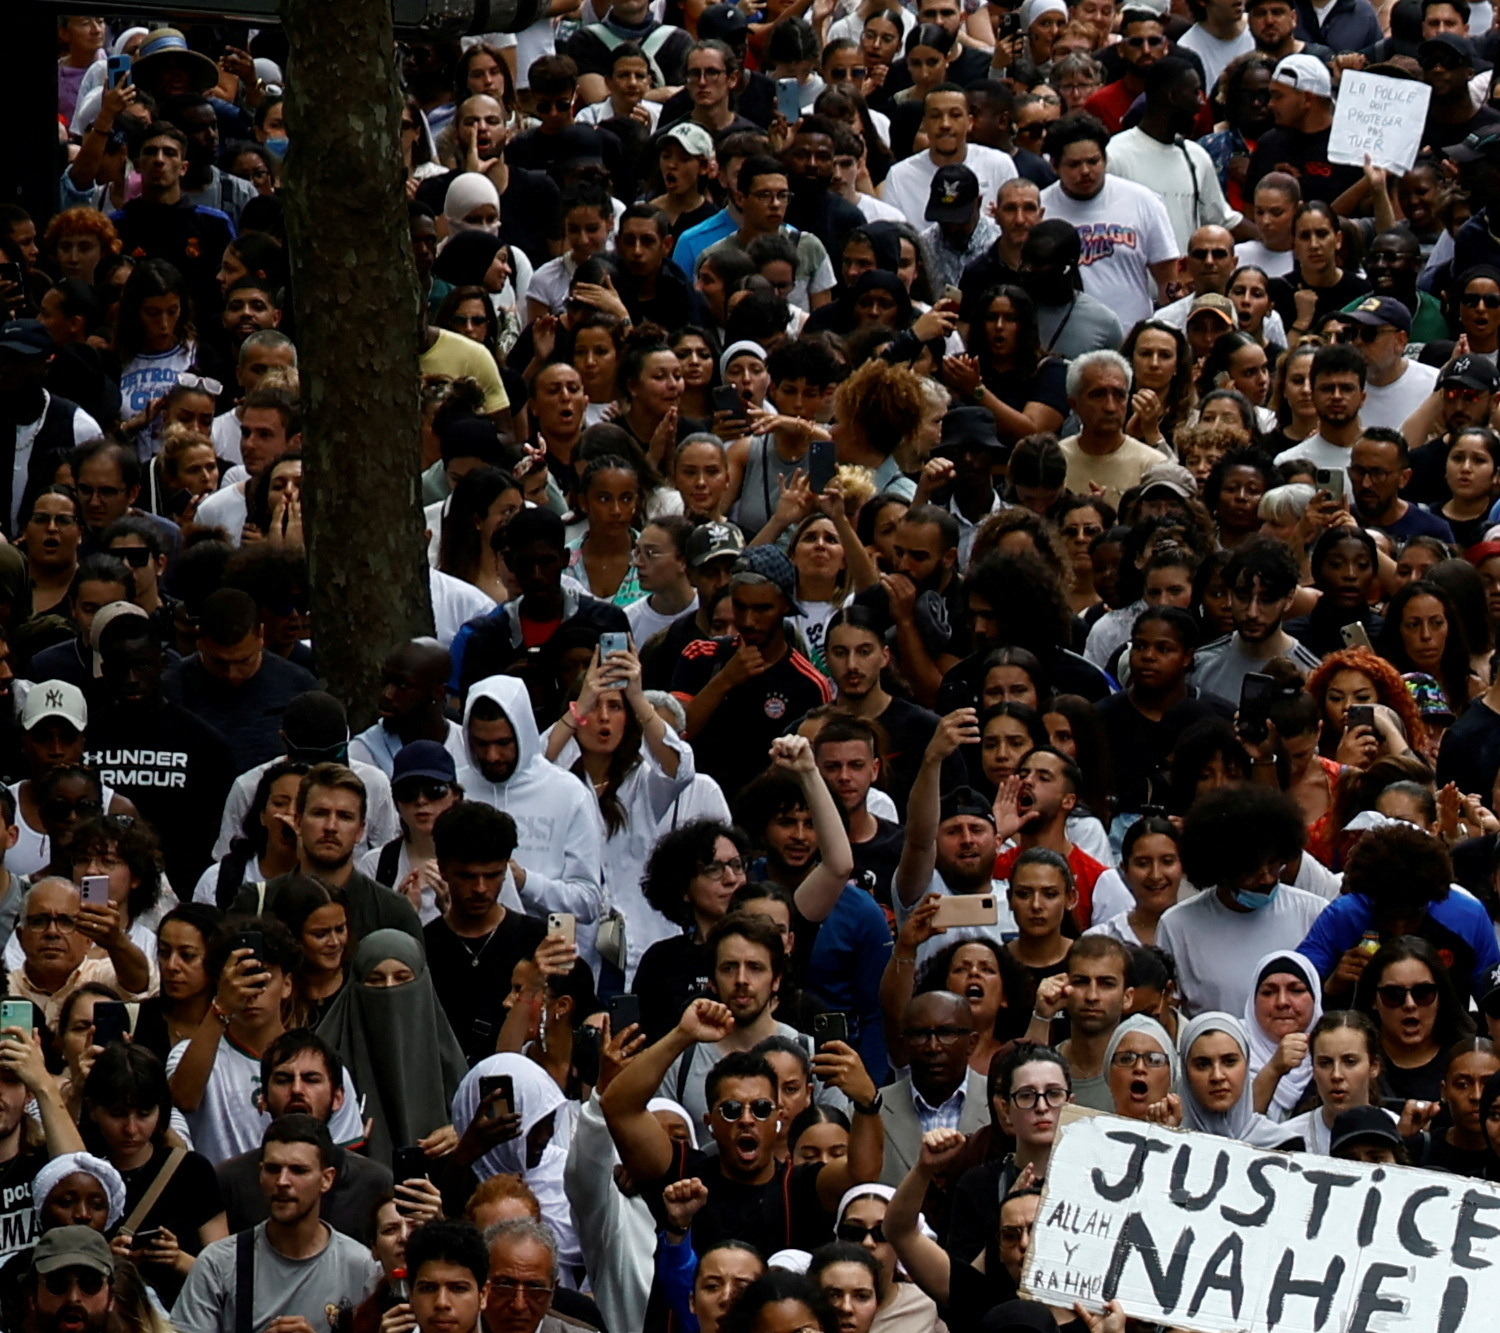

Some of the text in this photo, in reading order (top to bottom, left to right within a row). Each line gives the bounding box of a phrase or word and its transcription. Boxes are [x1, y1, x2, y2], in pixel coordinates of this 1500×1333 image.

[1374, 83, 1420, 104] POLICE
[1347, 134, 1386, 152] TUER
[101, 750, 188, 768] UNDER
[101, 770, 188, 789] RMOUR
[3, 1183, 33, 1209] pou
[1047, 1199, 1113, 1240] ALLAH
[1063, 1242, 1081, 1268] Y
